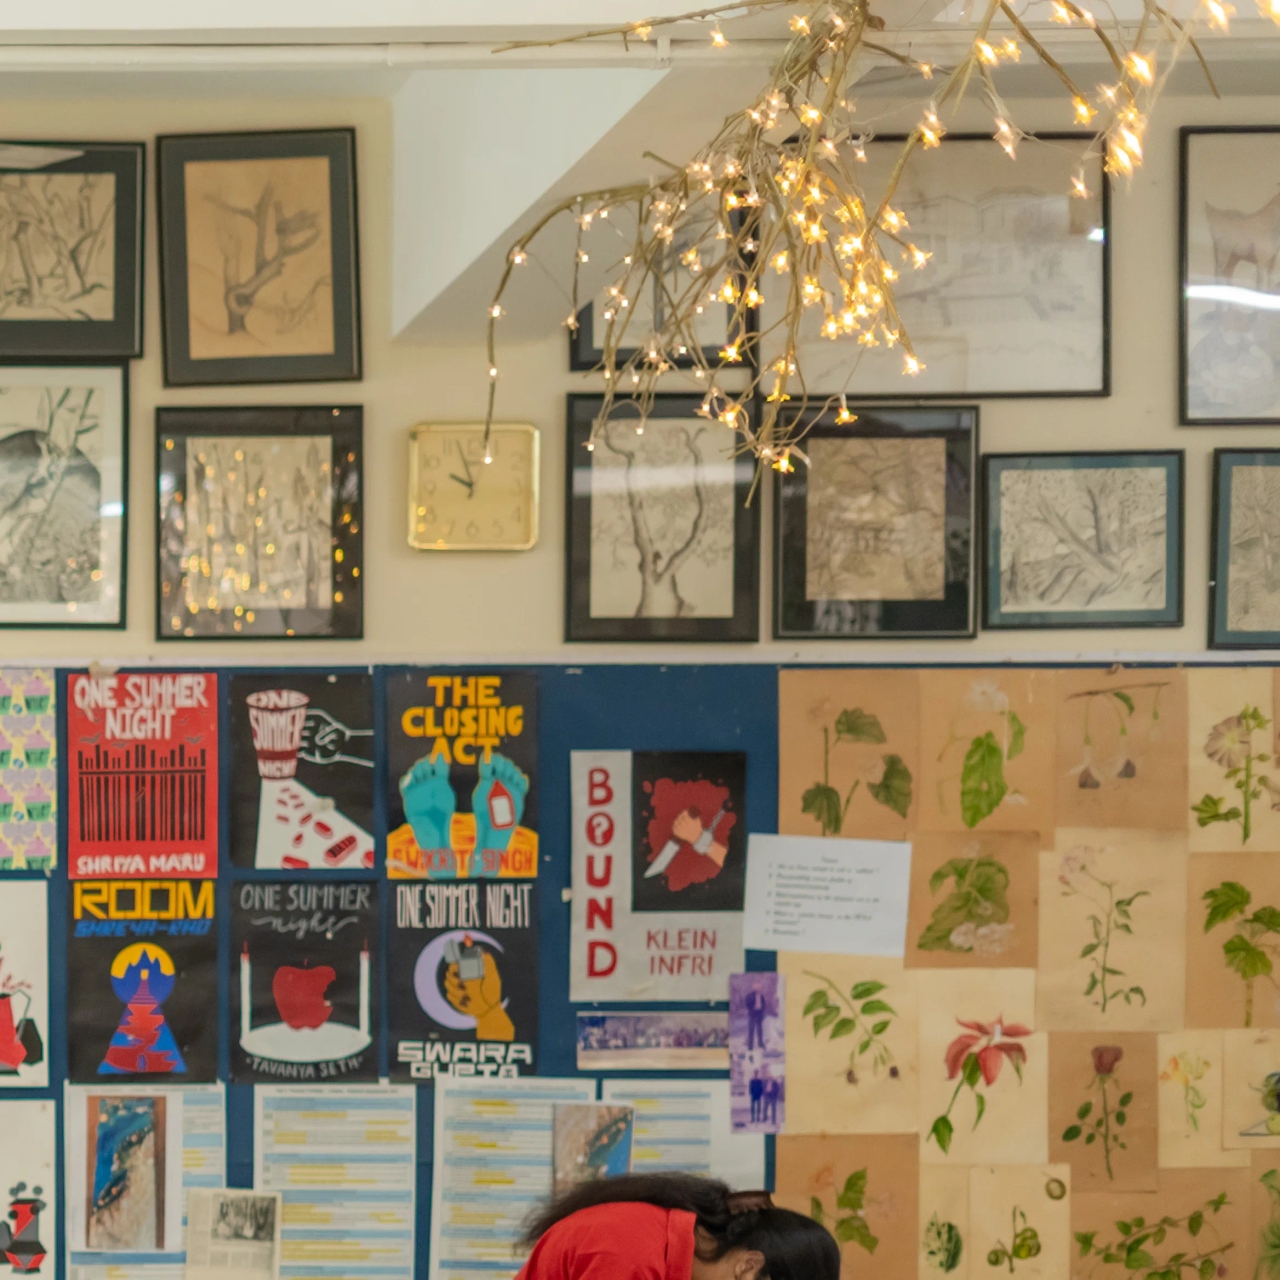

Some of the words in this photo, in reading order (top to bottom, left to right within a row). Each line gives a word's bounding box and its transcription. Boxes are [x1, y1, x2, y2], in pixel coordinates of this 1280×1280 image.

[74, 675, 118, 709] ONE
[124, 674, 209, 709] SUMMER
[427, 676, 502, 707] THE
[105, 707, 177, 740] NIGHT
[401, 705, 524, 737] CLOSING
[429, 736, 501, 765] ACT
[77, 854, 146, 875] SHRIYA
[149, 852, 206, 873] MARU
[482, 847, 533, 873] SINGH
[73, 880, 215, 920] ROOM
[240, 883, 282, 911] ONE
[285, 883, 372, 912] SUMMER
[396, 883, 424, 928] ONE
[425, 883, 480, 928] SUMMER
[486, 882, 533, 928] NIGHT
[646, 928, 717, 951] KLEIN
[649, 953, 714, 976] INFRI
[397, 1040, 532, 1065] SWARA
[410, 1062, 519, 1079] GUPTA
